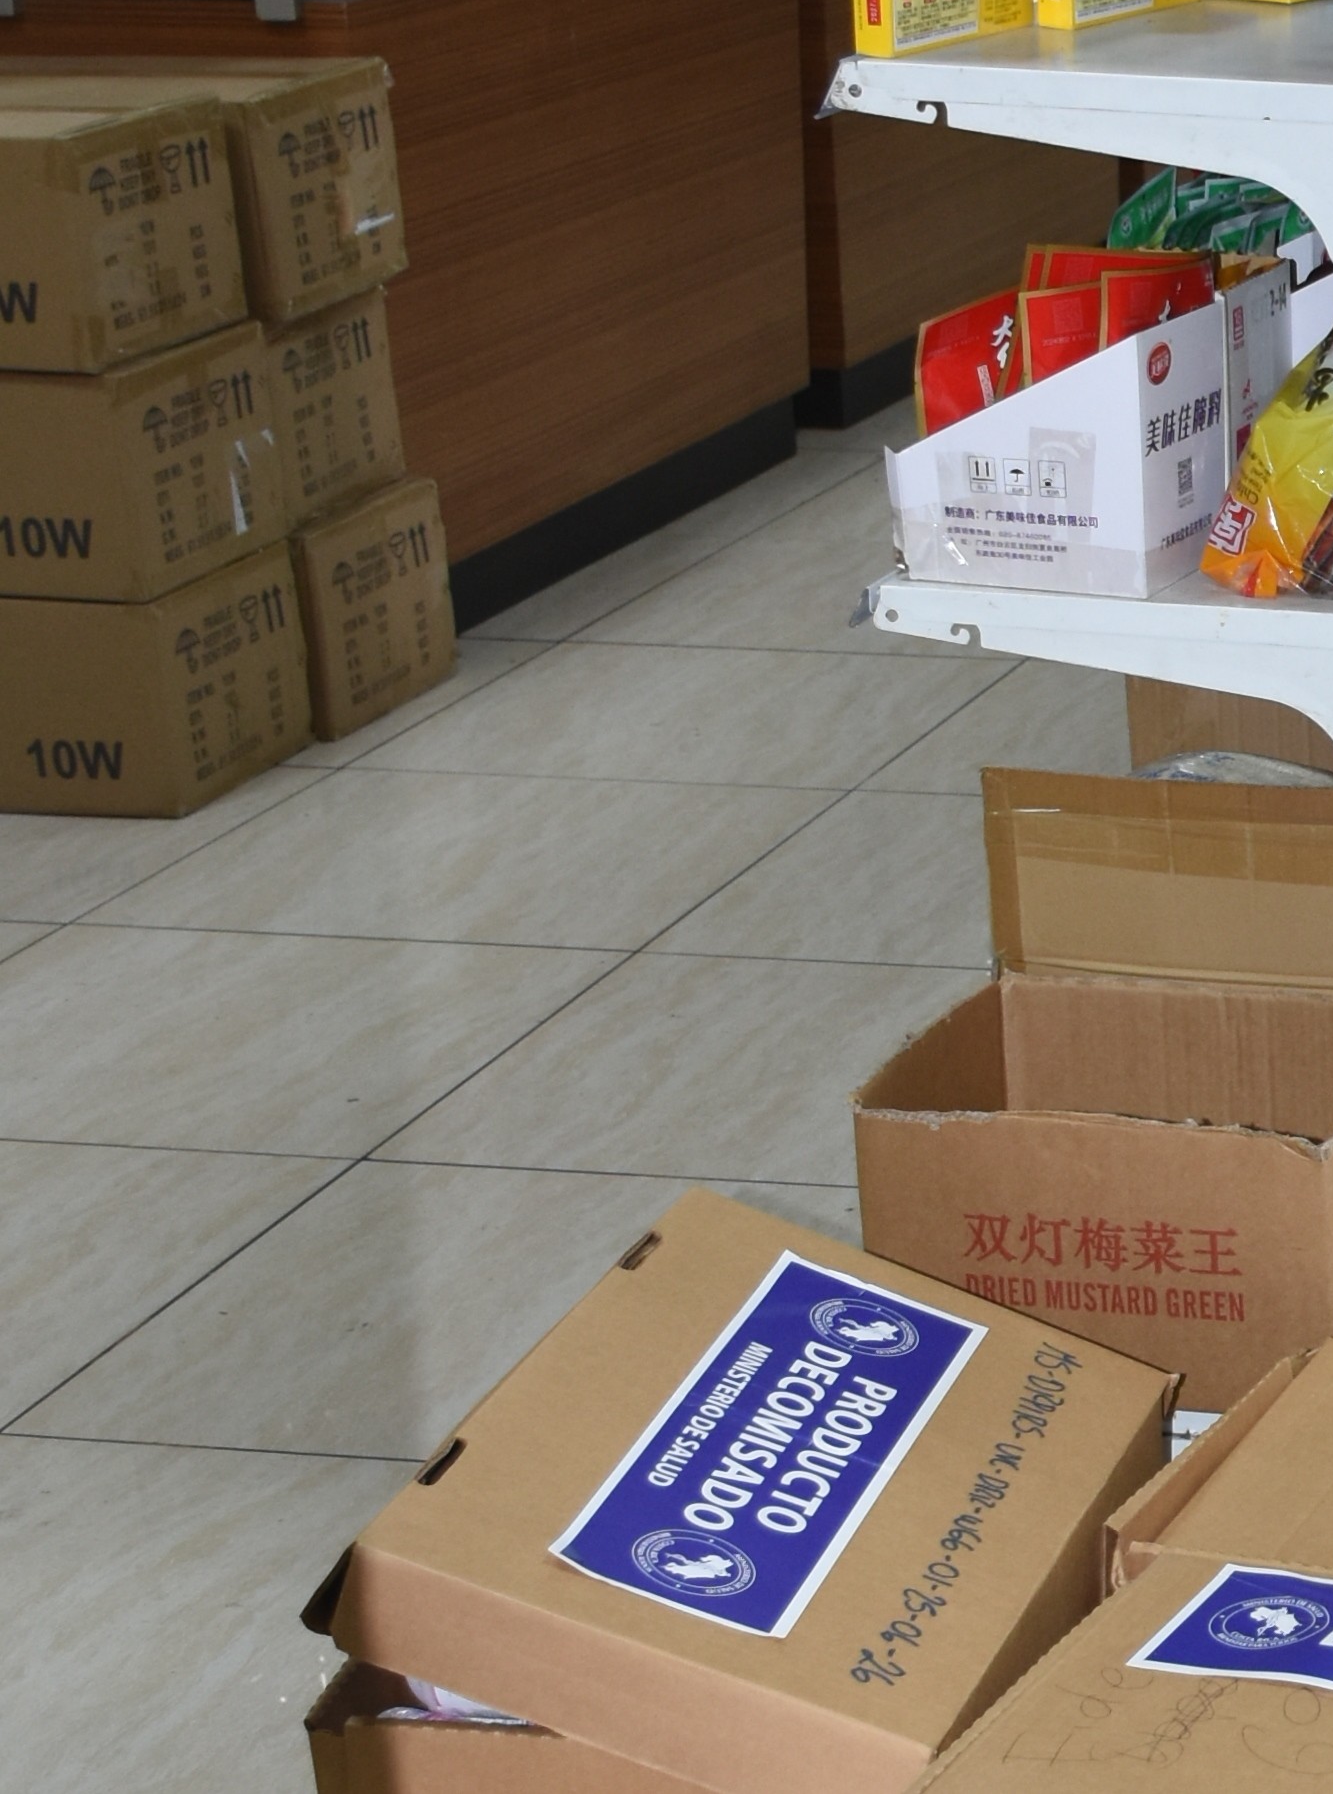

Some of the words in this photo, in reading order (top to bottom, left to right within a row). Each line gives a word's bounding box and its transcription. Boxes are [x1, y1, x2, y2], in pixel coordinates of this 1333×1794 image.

[1144, 387, 1222, 458] 美味佳腌料
[984, 509, 1100, 529] 广东美味佳食品有限公司
[26, 738, 124, 781] 10W
[962, 1212, 1244, 1277] 双灯梅菜王
[965, 1272, 1038, 1309] DRIED
[1044, 1279, 1159, 1317] MUSTARD
[1165, 1287, 1246, 1322] GREEN
[700, 1341, 774, 1419] MINISTERIO
[682, 1415, 717, 1440] DE
[683, 1339, 853, 1532] DECOMISADO
[756, 1375, 898, 1534] PRODUCTO
[647, 1436, 700, 1487] SALUD
